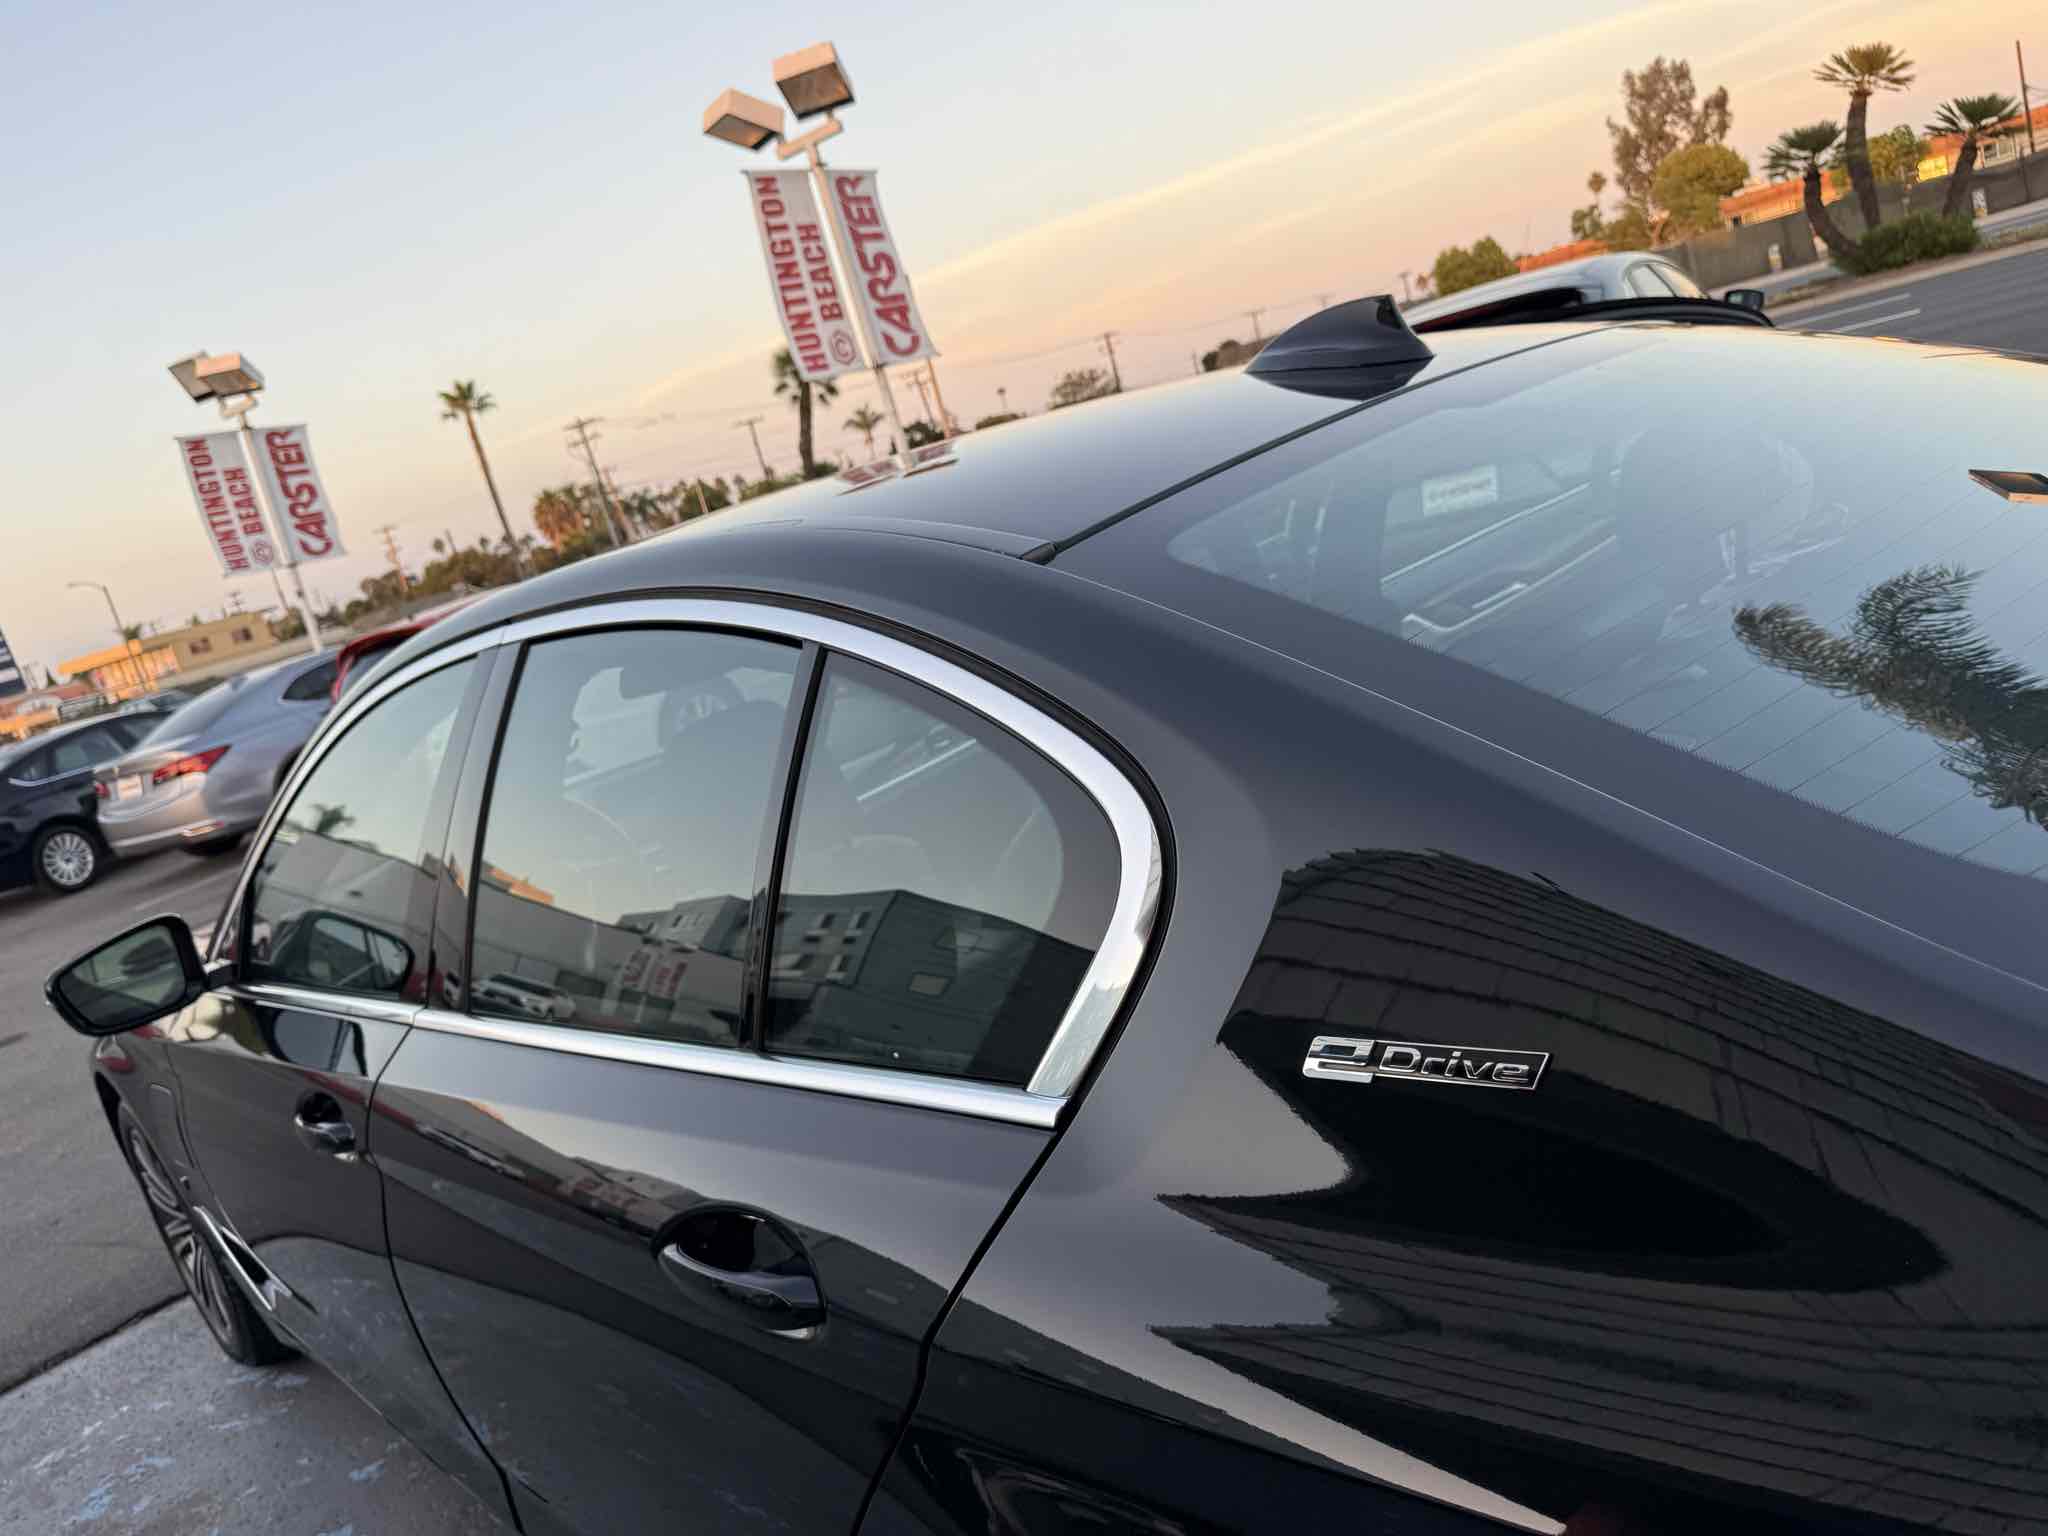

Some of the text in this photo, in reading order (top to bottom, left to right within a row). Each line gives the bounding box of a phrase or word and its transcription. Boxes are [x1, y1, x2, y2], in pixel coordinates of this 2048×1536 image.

[755, 176, 829, 373] HUNTINGTON
[797, 223, 844, 321] BEACH
[835, 176, 921, 356] CARSTER
[184, 437, 250, 570] HUNTINGTON
[223, 468, 265, 536] BEACH
[266, 431, 334, 556] CARSTER
